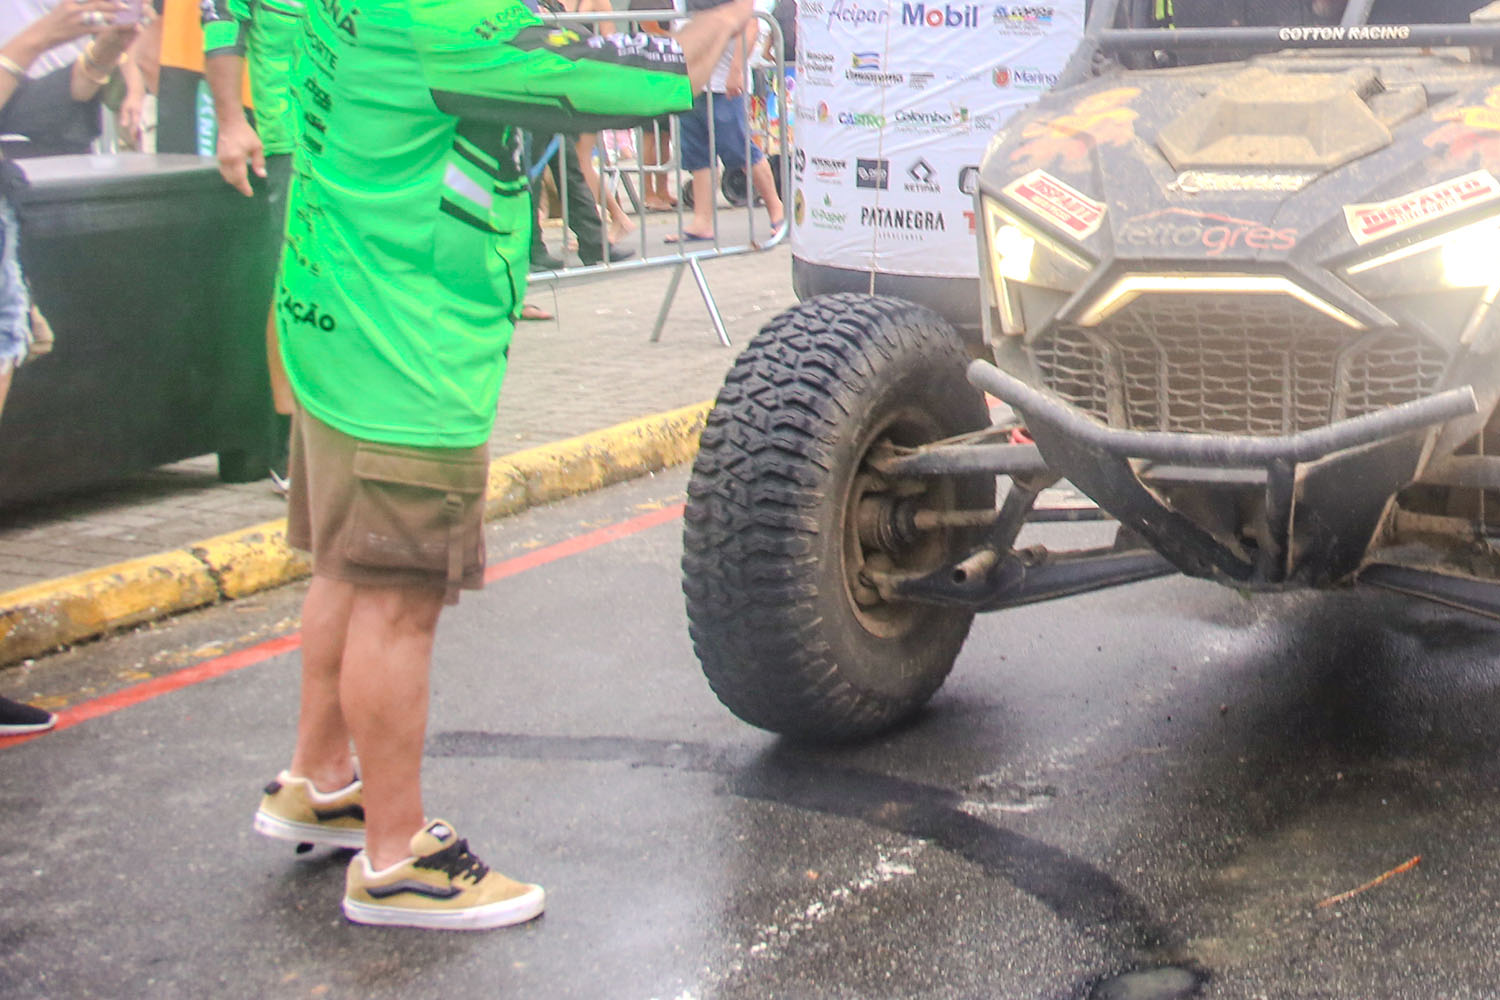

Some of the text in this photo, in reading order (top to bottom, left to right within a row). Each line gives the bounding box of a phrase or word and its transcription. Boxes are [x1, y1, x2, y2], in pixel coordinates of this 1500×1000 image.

[902, 3, 978, 28] Mobil
[1279, 25, 1411, 41] COTTON RACING
[1014, 70, 1059, 85] Maring
[860, 205, 946, 232] PATANEGRA
